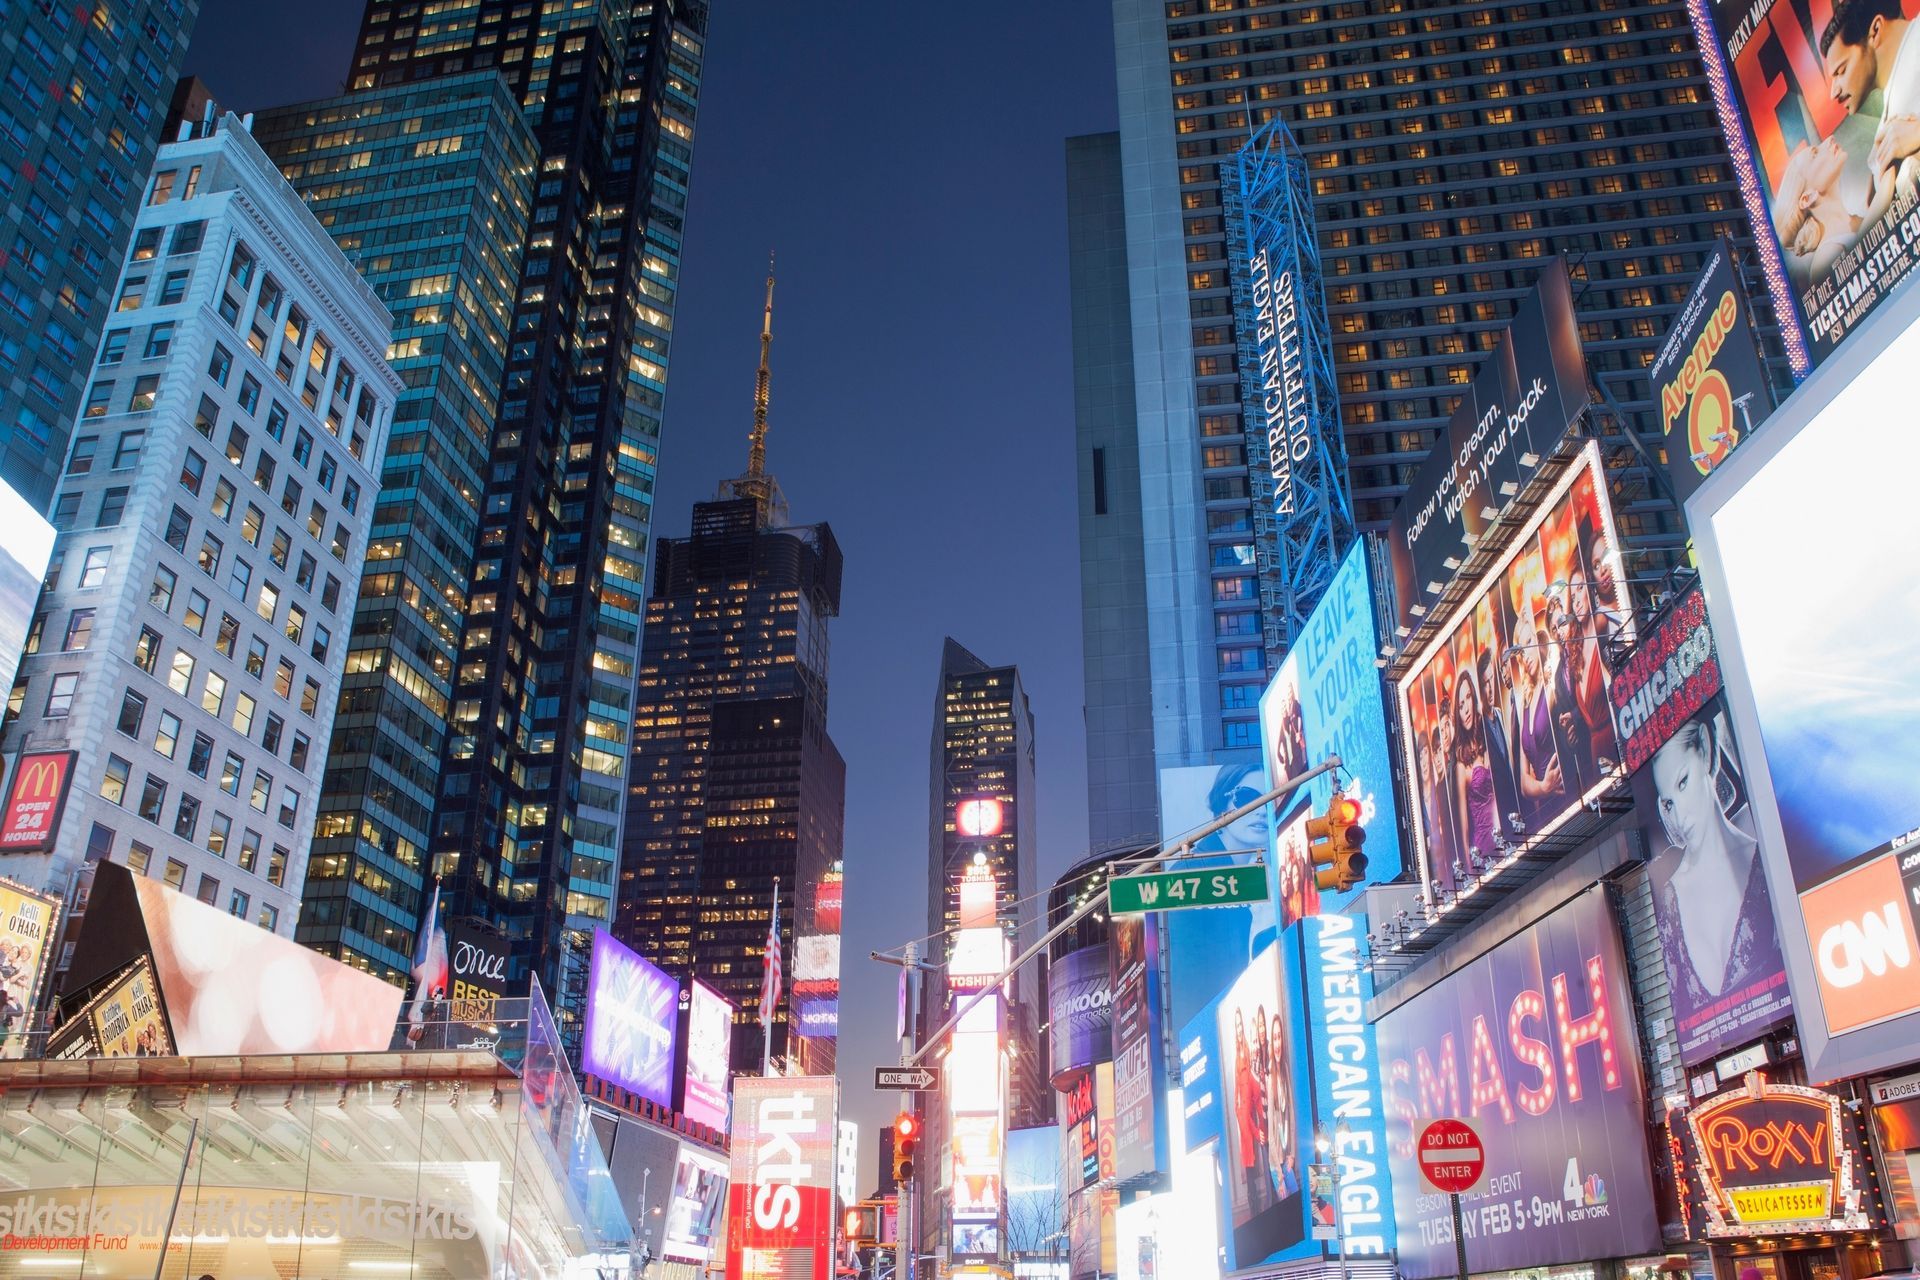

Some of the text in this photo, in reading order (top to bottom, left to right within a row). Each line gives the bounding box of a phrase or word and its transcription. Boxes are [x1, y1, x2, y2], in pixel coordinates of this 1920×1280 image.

[1727, 23, 1753, 63] RICKY
[1803, 187, 1920, 320] TIM RICE ANDREW LLOYD WEBBER
[1808, 206, 1920, 342] TICKETMASTER.CO
[1843, 287, 1877, 328] MARQUIS
[1876, 252, 1913, 293] THEATRE,
[1667, 296, 1708, 366] BEST MUSICAL
[1250, 248, 1295, 515] AMERICAN EAGLE
[1274, 271, 1310, 462] OUTFITTERS
[1661, 290, 1737, 437] Avenue
[1688, 369, 1741, 478] Q
[1444, 377, 1547, 525] Watch your back.
[1406, 404, 1501, 549] Follow your dream.
[1305, 572, 1355, 681] LEAVE
[1613, 590, 1705, 707] CHICAGO
[1314, 637, 1362, 728] YOUR
[1618, 624, 1711, 740] CHICAGO
[1625, 658, 1719, 771] CHICAGO
[15, 813, 44, 830] 24
[16, 801, 51, 813] OPEN
[3, 830, 48, 842] HOURS
[1891, 835, 1906, 849] For
[961, 874, 995, 883] TOSHIBA
[1138, 875, 1239, 904] W 47 St
[8, 915, 41, 941] O'HARA
[19, 901, 40, 921] Kelli
[1816, 900, 1911, 989] CNN
[131, 978, 145, 998] Kelli
[453, 979, 500, 1014] BEST
[949, 975, 1004, 988] TOSHIB
[101, 1000, 122, 1022] Matthew
[101, 1011, 131, 1047] BRODERICK
[132, 994, 153, 1022] O'HARA
[451, 1000, 497, 1026] MUSICAL
[679, 1002, 689, 1010] LG
[884, 1073, 930, 1083] ONE WAY
[1115, 1050, 1129, 1088] FOX
[1128, 1033, 1147, 1080] UFC
[1388, 954, 1623, 1162] SMASH
[1067, 1072, 1093, 1126] Kodak
[1116, 1070, 1149, 1117] SATURDAY
[1317, 913, 1386, 1257] AMERICAN EAGLE
[1888, 1083, 1917, 1099] ADOBE
[754, 1090, 817, 1231] tkts
[1427, 1132, 1470, 1146] DO NOT
[1099, 1118, 1117, 1218] Kodak
[1434, 1166, 1472, 1179] ENTER
[1563, 1157, 1585, 1208] 4
[1673, 1137, 1693, 1220] ROXY
[1415, 1193, 1448, 1215] SEASON
[1490, 1171, 1522, 1197] EVENT
[1567, 1204, 1610, 1222] NEW YORK
[1737, 1193, 1825, 1215] DELICATESSEN
[3, 1233, 90, 1253] Development
[93, 1233, 129, 1250] Fund
[1418, 1205, 1478, 1248] TUESAY
[1481, 1200, 1512, 1236] FEB
